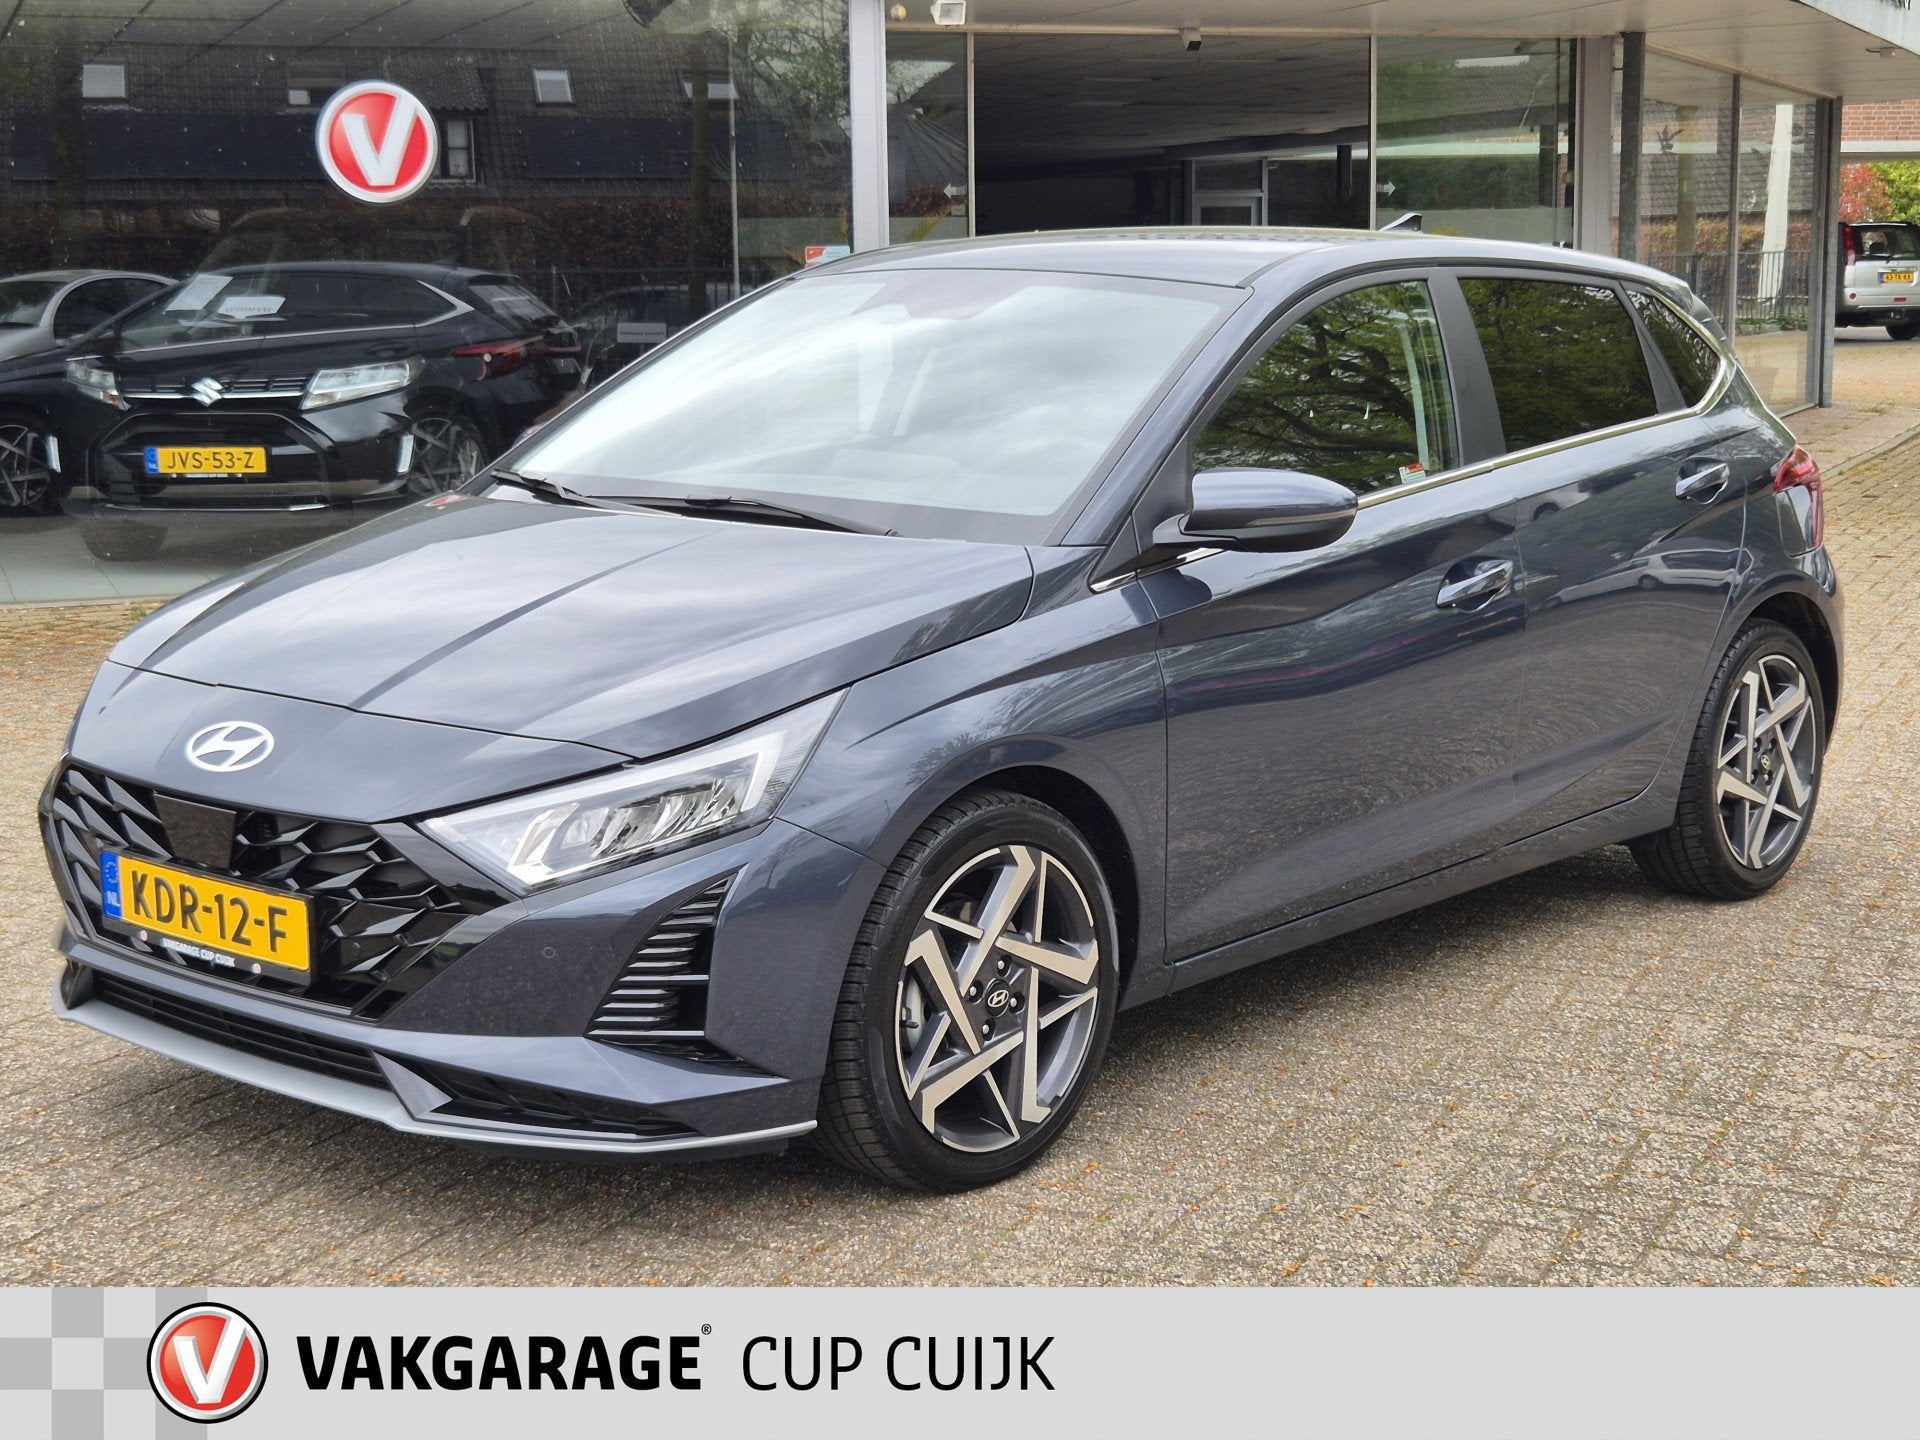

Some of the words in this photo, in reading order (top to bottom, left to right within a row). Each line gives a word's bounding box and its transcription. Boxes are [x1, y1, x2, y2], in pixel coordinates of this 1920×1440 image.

[167, 451, 255, 470] JVS-53-Z
[107, 890, 121, 908] NL
[131, 870, 288, 953] KDR-12-F
